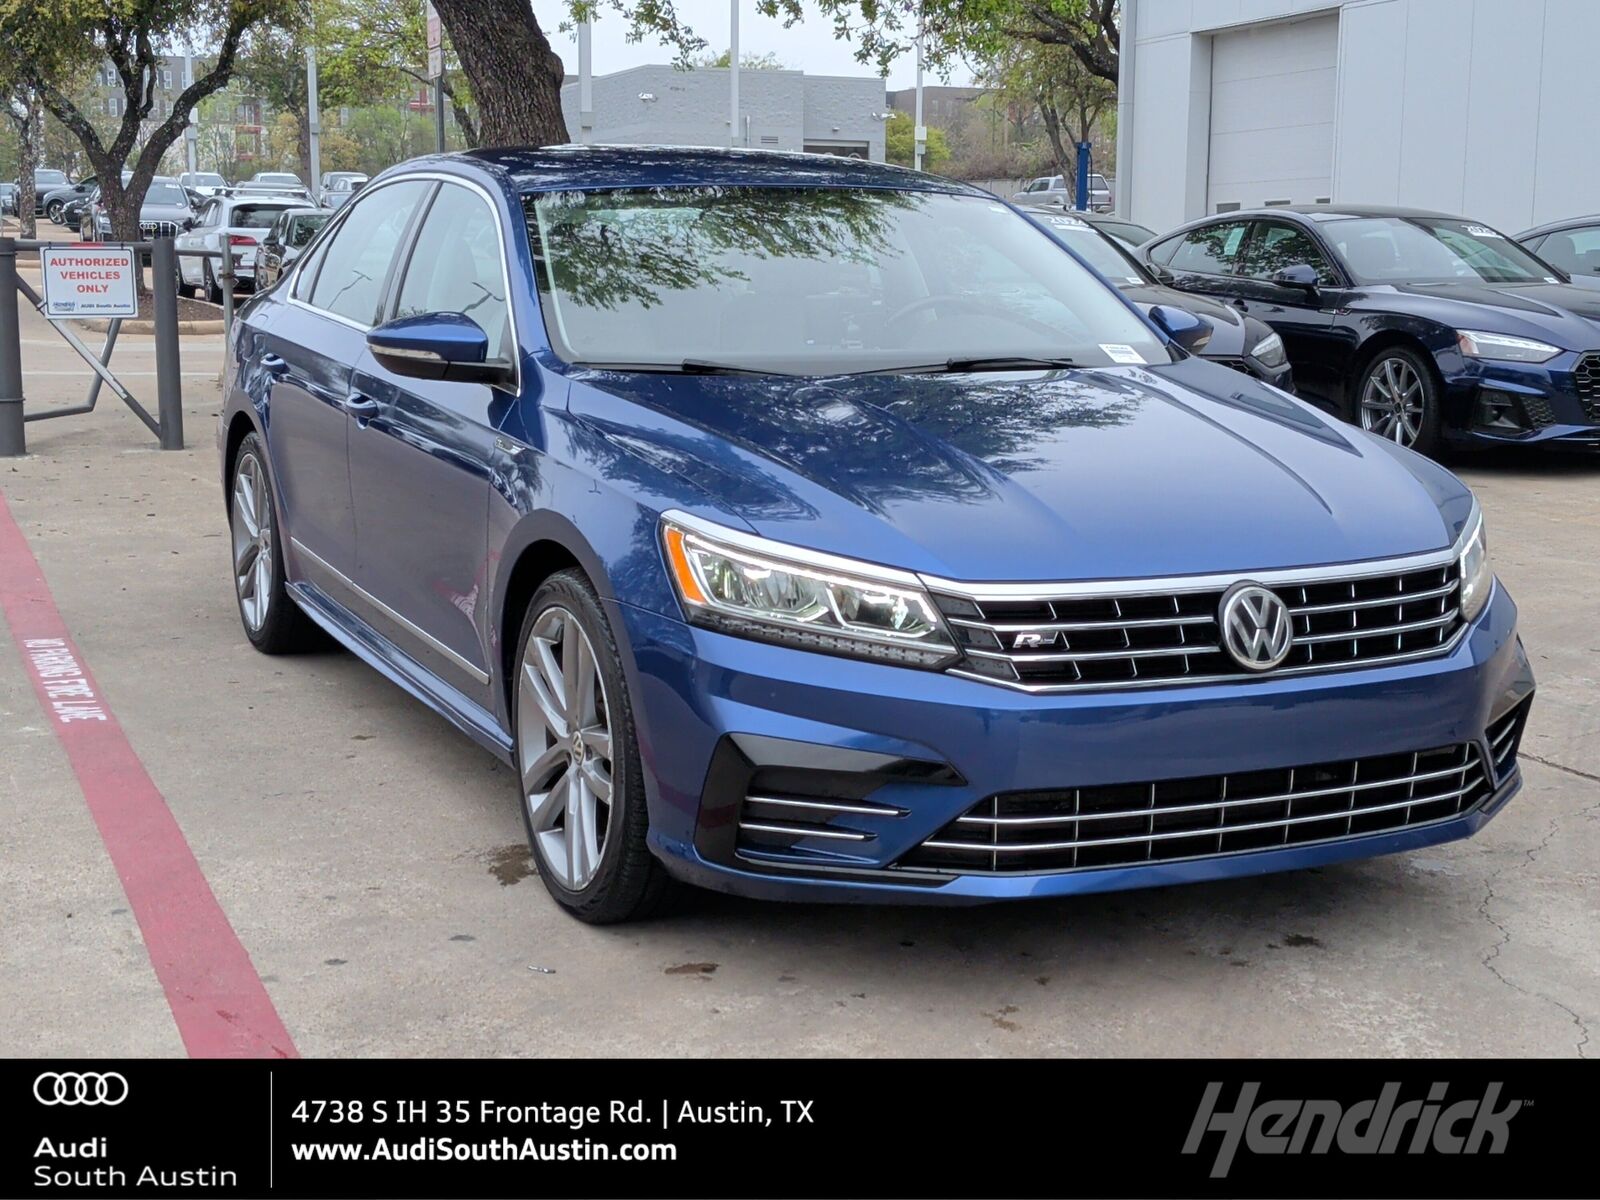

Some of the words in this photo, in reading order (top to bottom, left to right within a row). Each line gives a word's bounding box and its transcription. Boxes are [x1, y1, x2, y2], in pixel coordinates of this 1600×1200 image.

[51, 258, 129, 266] AUTHORIZED
[60, 271, 121, 280] VEHICLES
[76, 284, 109, 293] ONLY
[42, 678, 94, 698] FIRE
[52, 700, 107, 723] LANE
